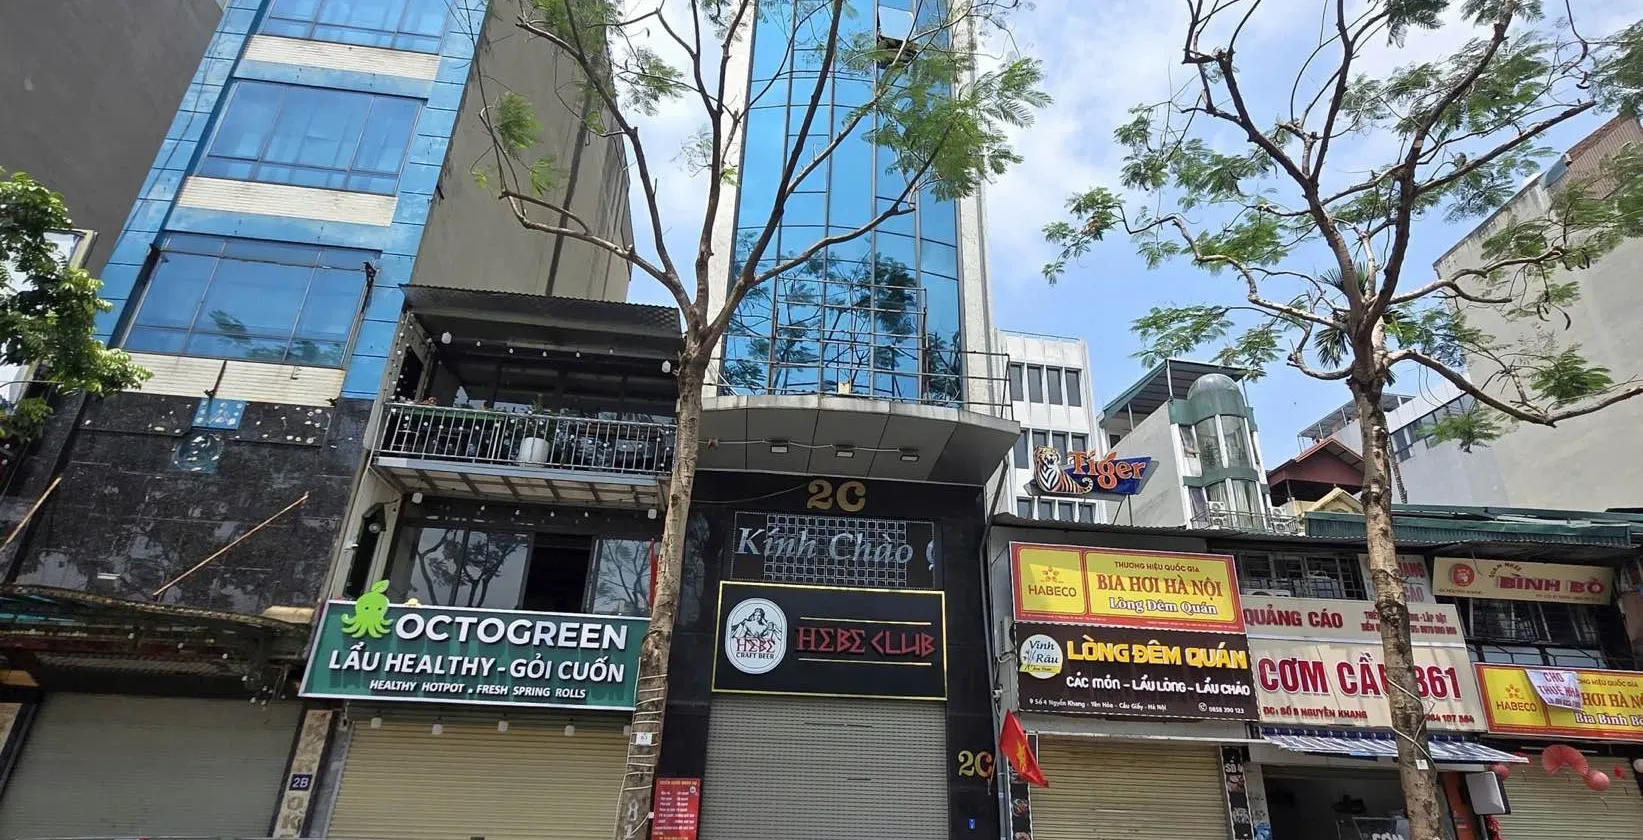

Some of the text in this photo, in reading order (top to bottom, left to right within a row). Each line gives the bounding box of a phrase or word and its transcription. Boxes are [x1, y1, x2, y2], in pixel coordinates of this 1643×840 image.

[1067, 450, 1147, 490] Tiger
[807, 479, 866, 512] 2C
[735, 527, 817, 559] Kính
[829, 532, 914, 564] Chào
[1028, 585, 1077, 598] HABECO
[1096, 574, 1126, 591] BIA
[1163, 574, 1188, 595] HÀ
[1191, 576, 1223, 601] NỘI
[1499, 573, 1561, 592] BÌNH
[1109, 596, 1217, 615] Lòng Đêm Quán
[1243, 604, 1303, 627] QUẢNG
[1308, 608, 1344, 629] CÁO
[395, 613, 628, 650] OCTOGREEN
[870, 630, 936, 657] CLUB
[1066, 634, 1248, 669] LÒNG ĐÊM QUÁN
[329, 642, 381, 671] LẨU
[384, 652, 496, 677] HEALTHY
[509, 652, 553, 679] GỎI
[557, 656, 625, 682] CUỐN
[1066, 671, 1089, 688] CÁC
[1157, 677, 1186, 693] LÒNG
[1196, 677, 1219, 694] LẨU
[1222, 680, 1251, 696] CHÁO
[1258, 657, 1329, 693] CƠM
[1543, 672, 1564, 683] CHO
[370, 680, 417, 691] HEALTHY
[422, 682, 465, 693] HOTPOT
[476, 684, 509, 695] FRESH
[512, 686, 551, 697] SPRING
[555, 688, 587, 699] ROLLS
[1538, 683, 1565, 696] THUÊ
[1608, 690, 1628, 708] HÀ
[1067, 700, 1085, 708] Khang
[1280, 704, 1292, 716] SỐ
[1338, 710, 1368, 719] KHANG
[1496, 700, 1537, 712] HABECO
[1442, 714, 1456, 722] 107
[1575, 711, 1596, 724] Bia
[958, 750, 992, 777] 2C
[292, 777, 310, 788] 2B
